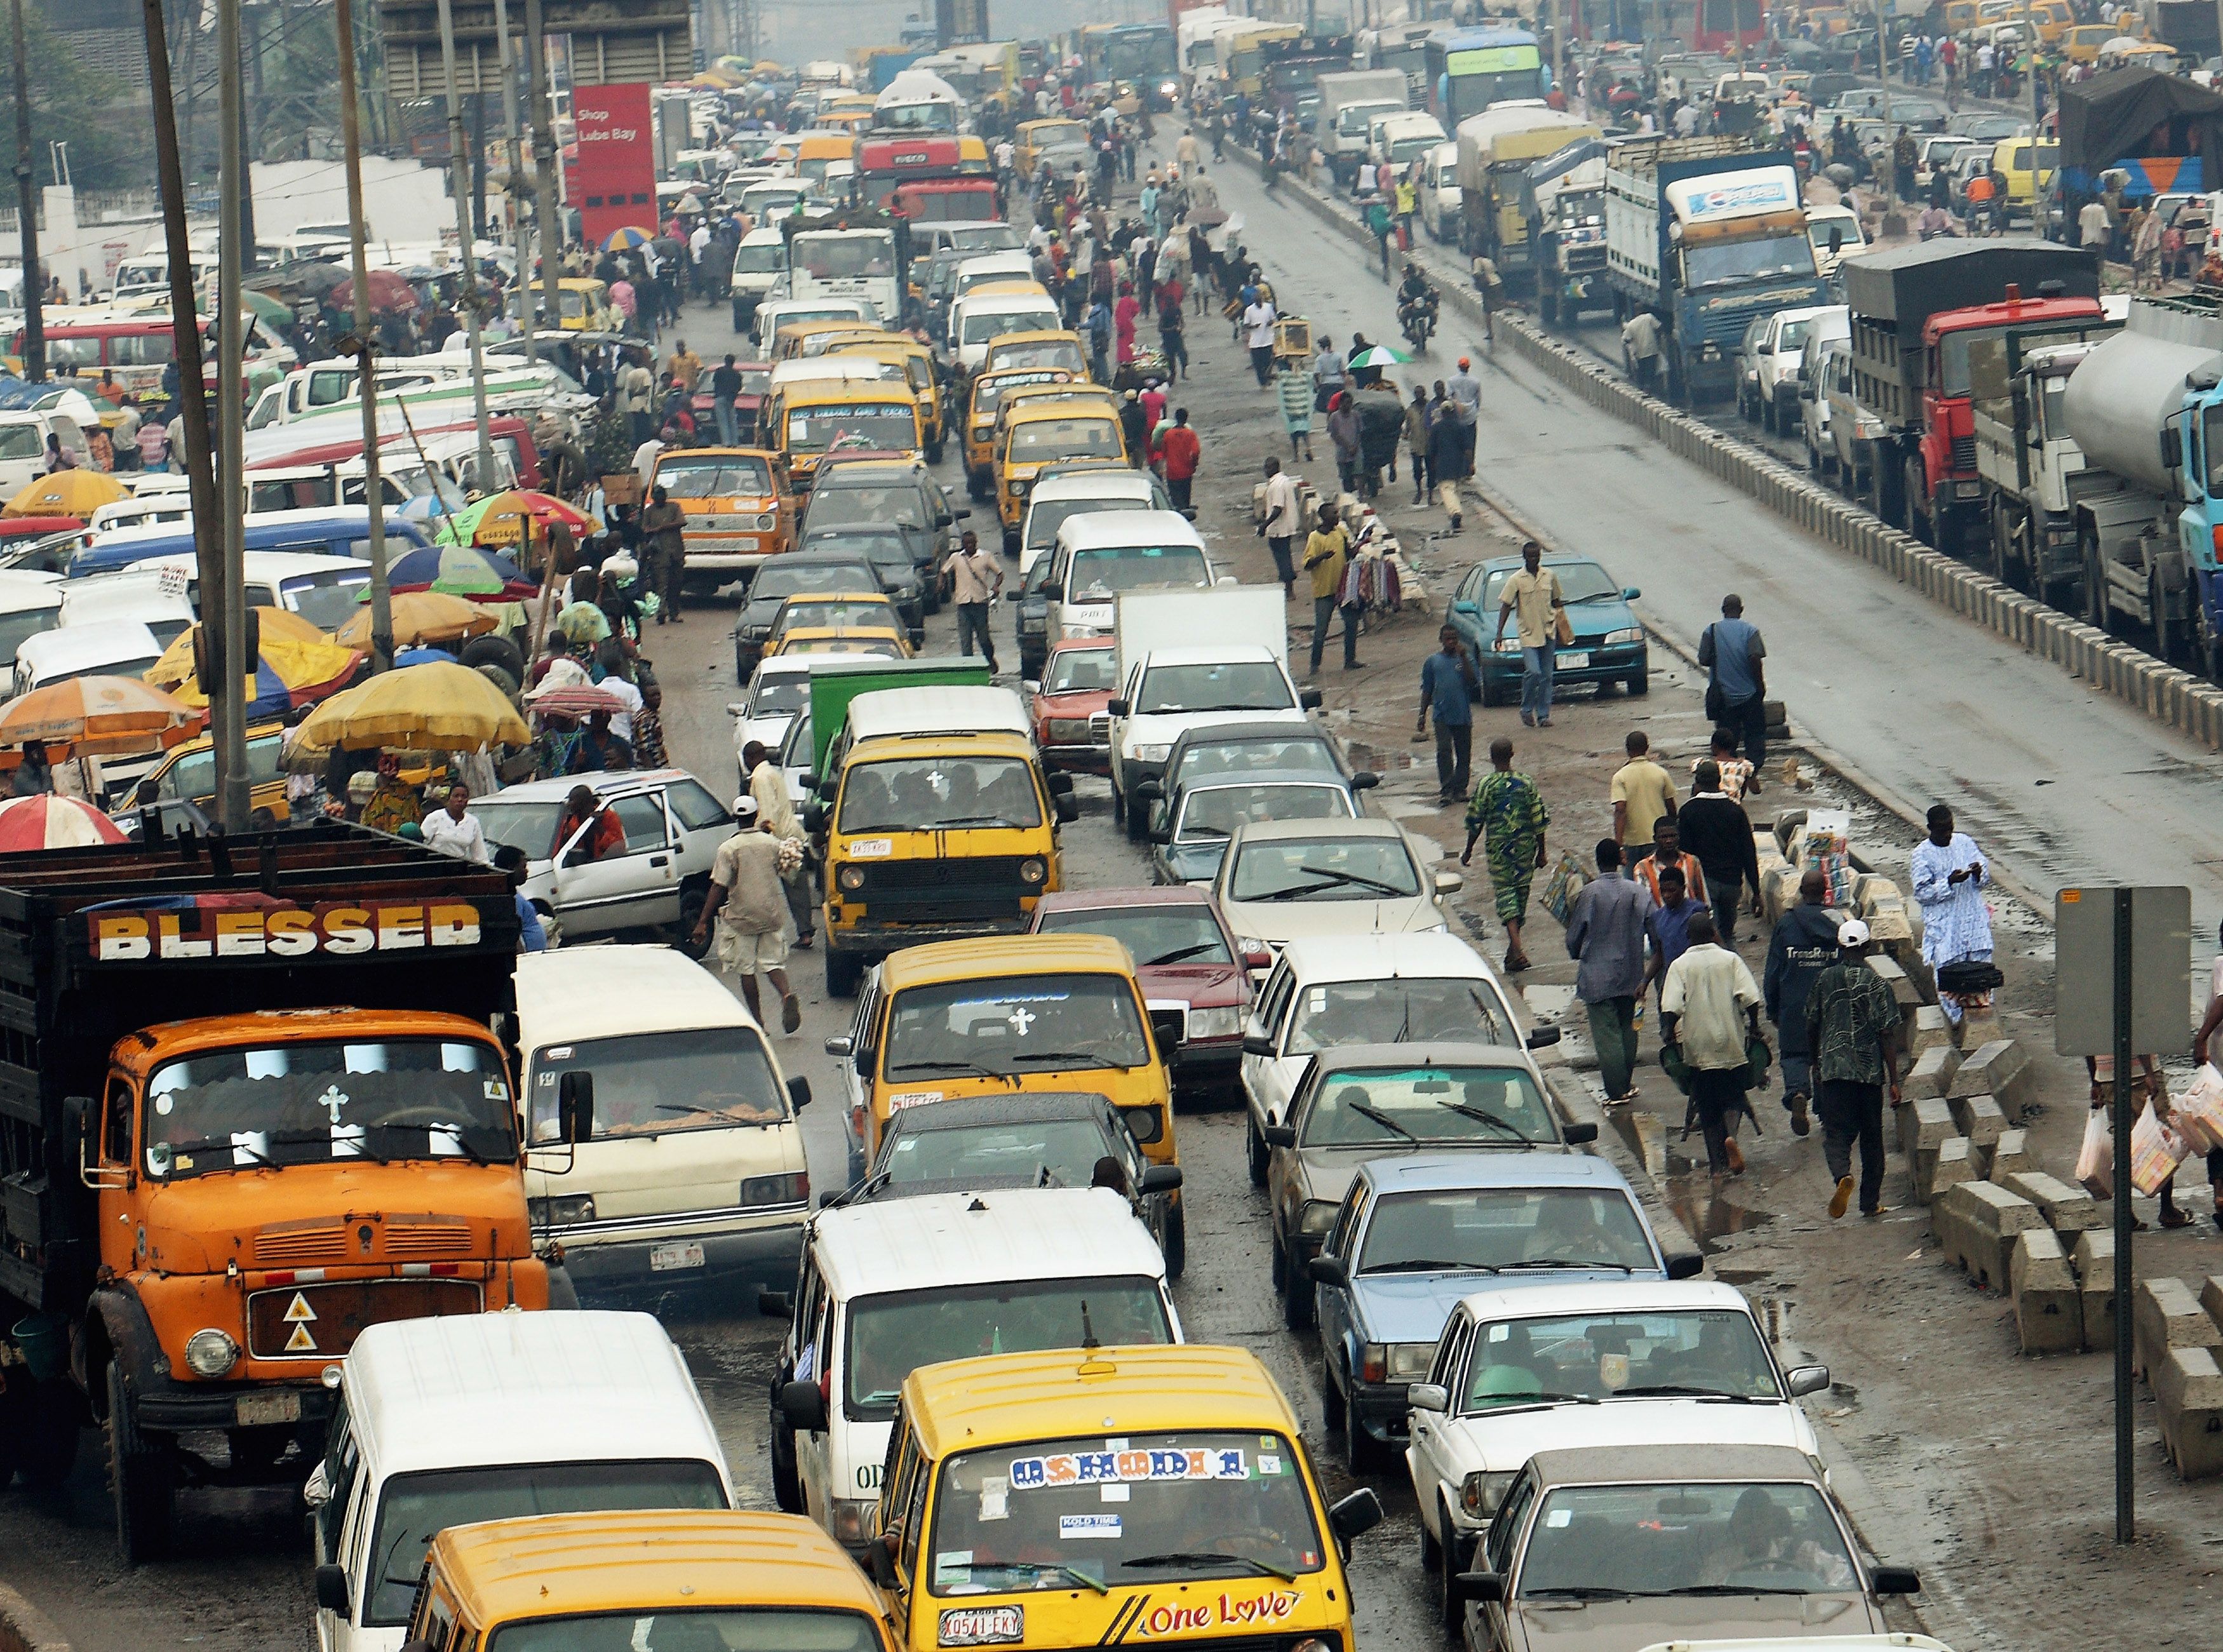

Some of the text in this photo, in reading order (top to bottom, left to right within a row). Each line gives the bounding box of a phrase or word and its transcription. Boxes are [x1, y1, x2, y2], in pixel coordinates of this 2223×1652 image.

[612, 128, 636, 141] Bay
[99, 904, 481, 961] BLESSED
[1011, 1449, 1211, 1487] OSHODI
[1218, 1451, 1246, 1477] 1
